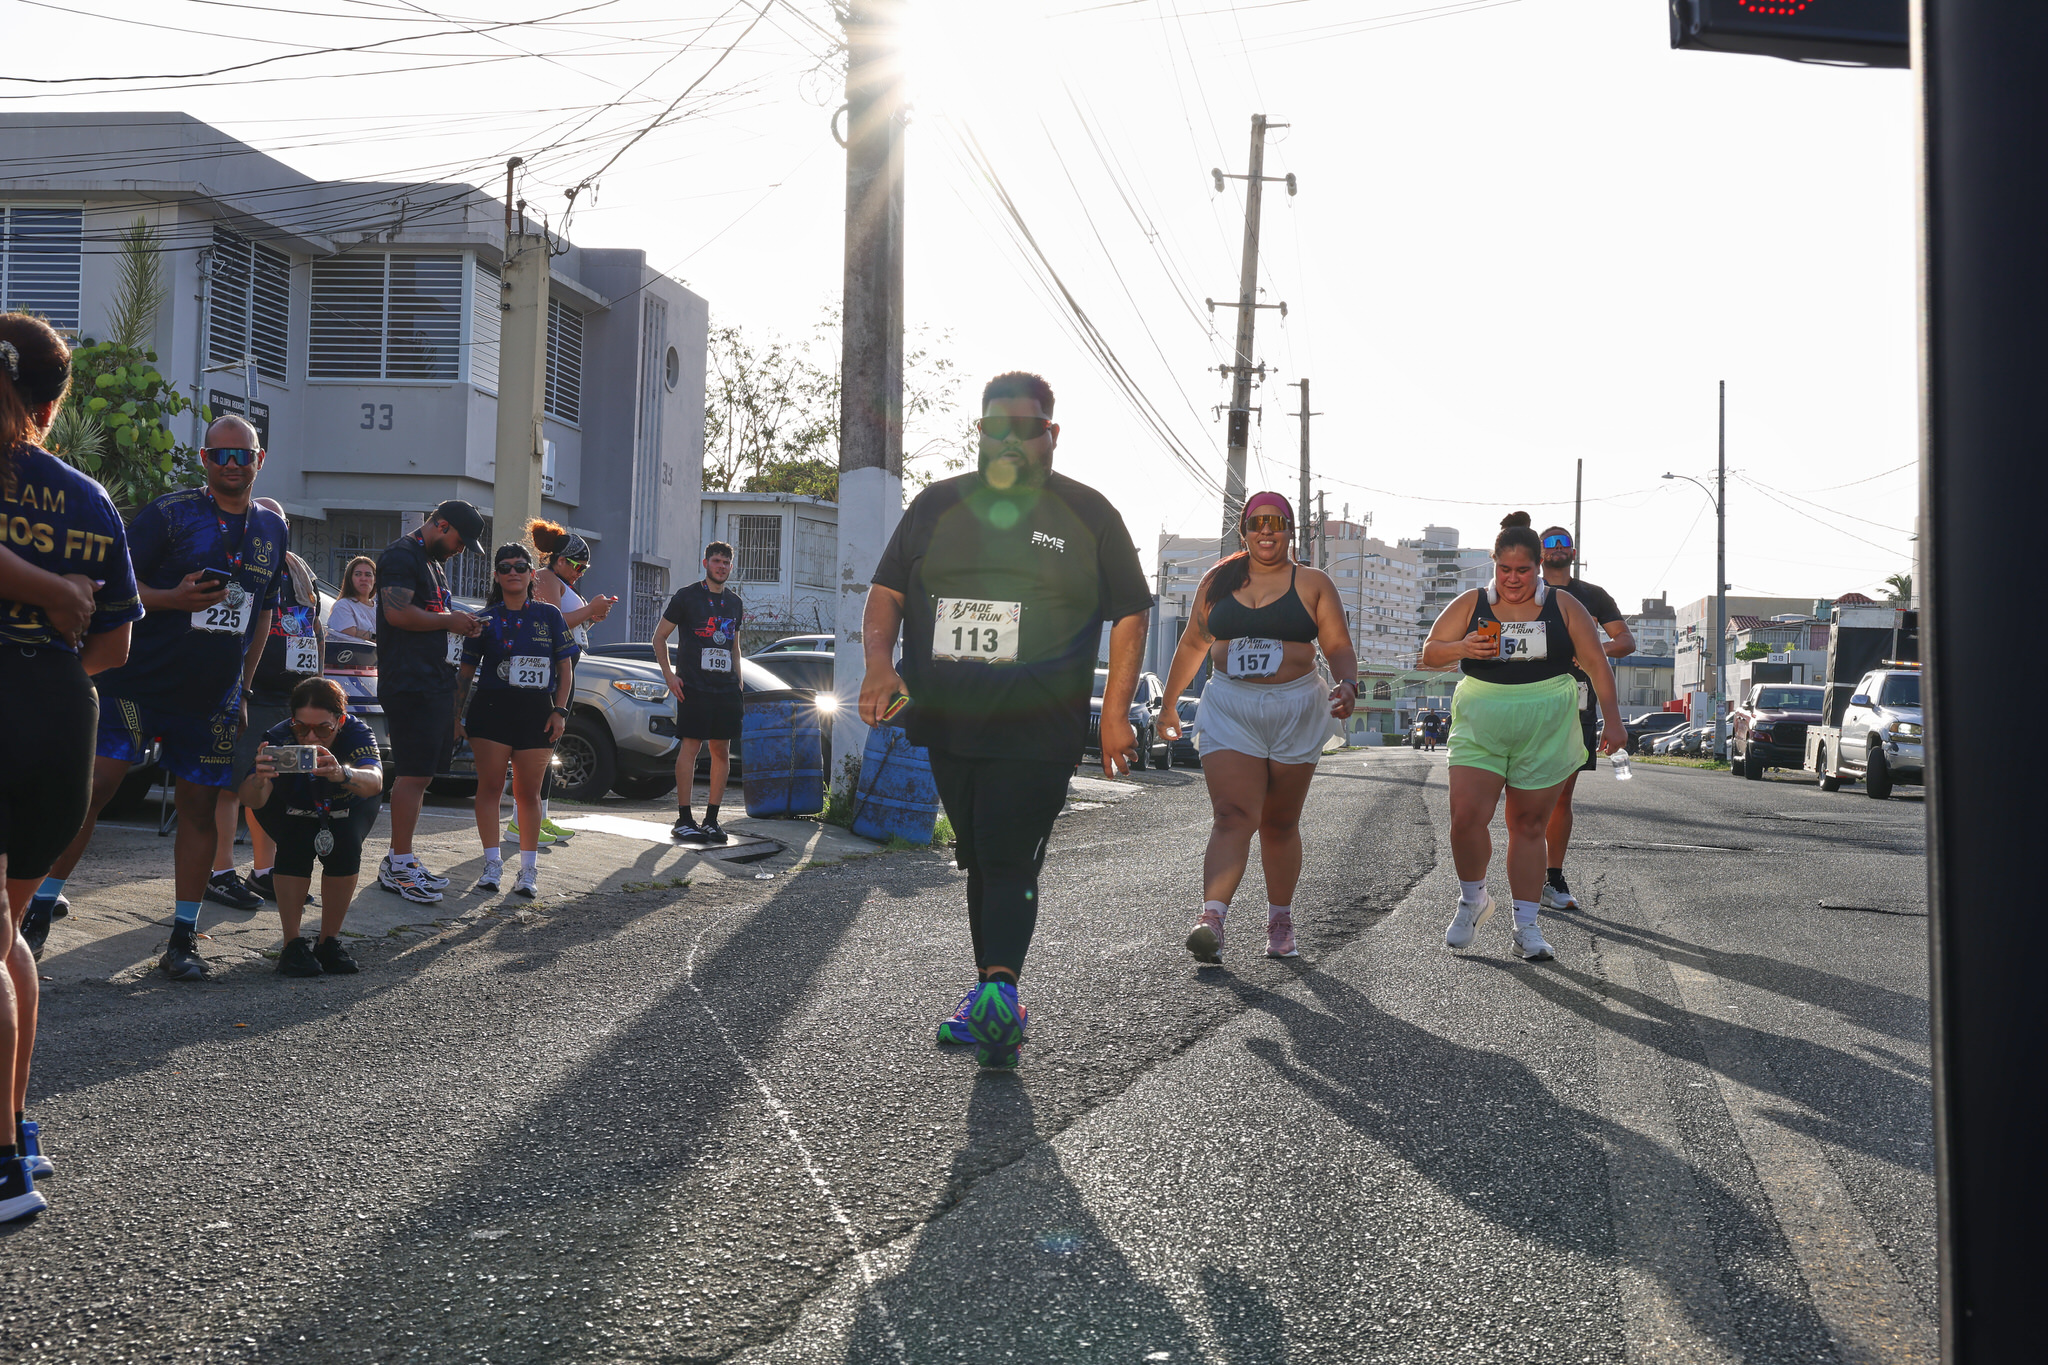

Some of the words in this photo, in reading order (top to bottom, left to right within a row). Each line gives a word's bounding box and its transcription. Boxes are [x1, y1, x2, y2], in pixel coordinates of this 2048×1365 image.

[361, 403, 393, 430] 33
[662, 462, 673, 486] 33
[4, 483, 65, 514] EAM
[64, 528, 113, 562] FIT
[1032, 531, 1065, 549] EME
[964, 602, 993, 613] FADE
[206, 608, 241, 628] 225
[977, 613, 1002, 622] RUN
[952, 626, 998, 653] 113
[1504, 638, 1528, 655] 54
[709, 658, 726, 668] 199
[1238, 654, 1270, 671] 157
[519, 670, 543, 683] 231
[200, 755, 231, 764] TAINOS
